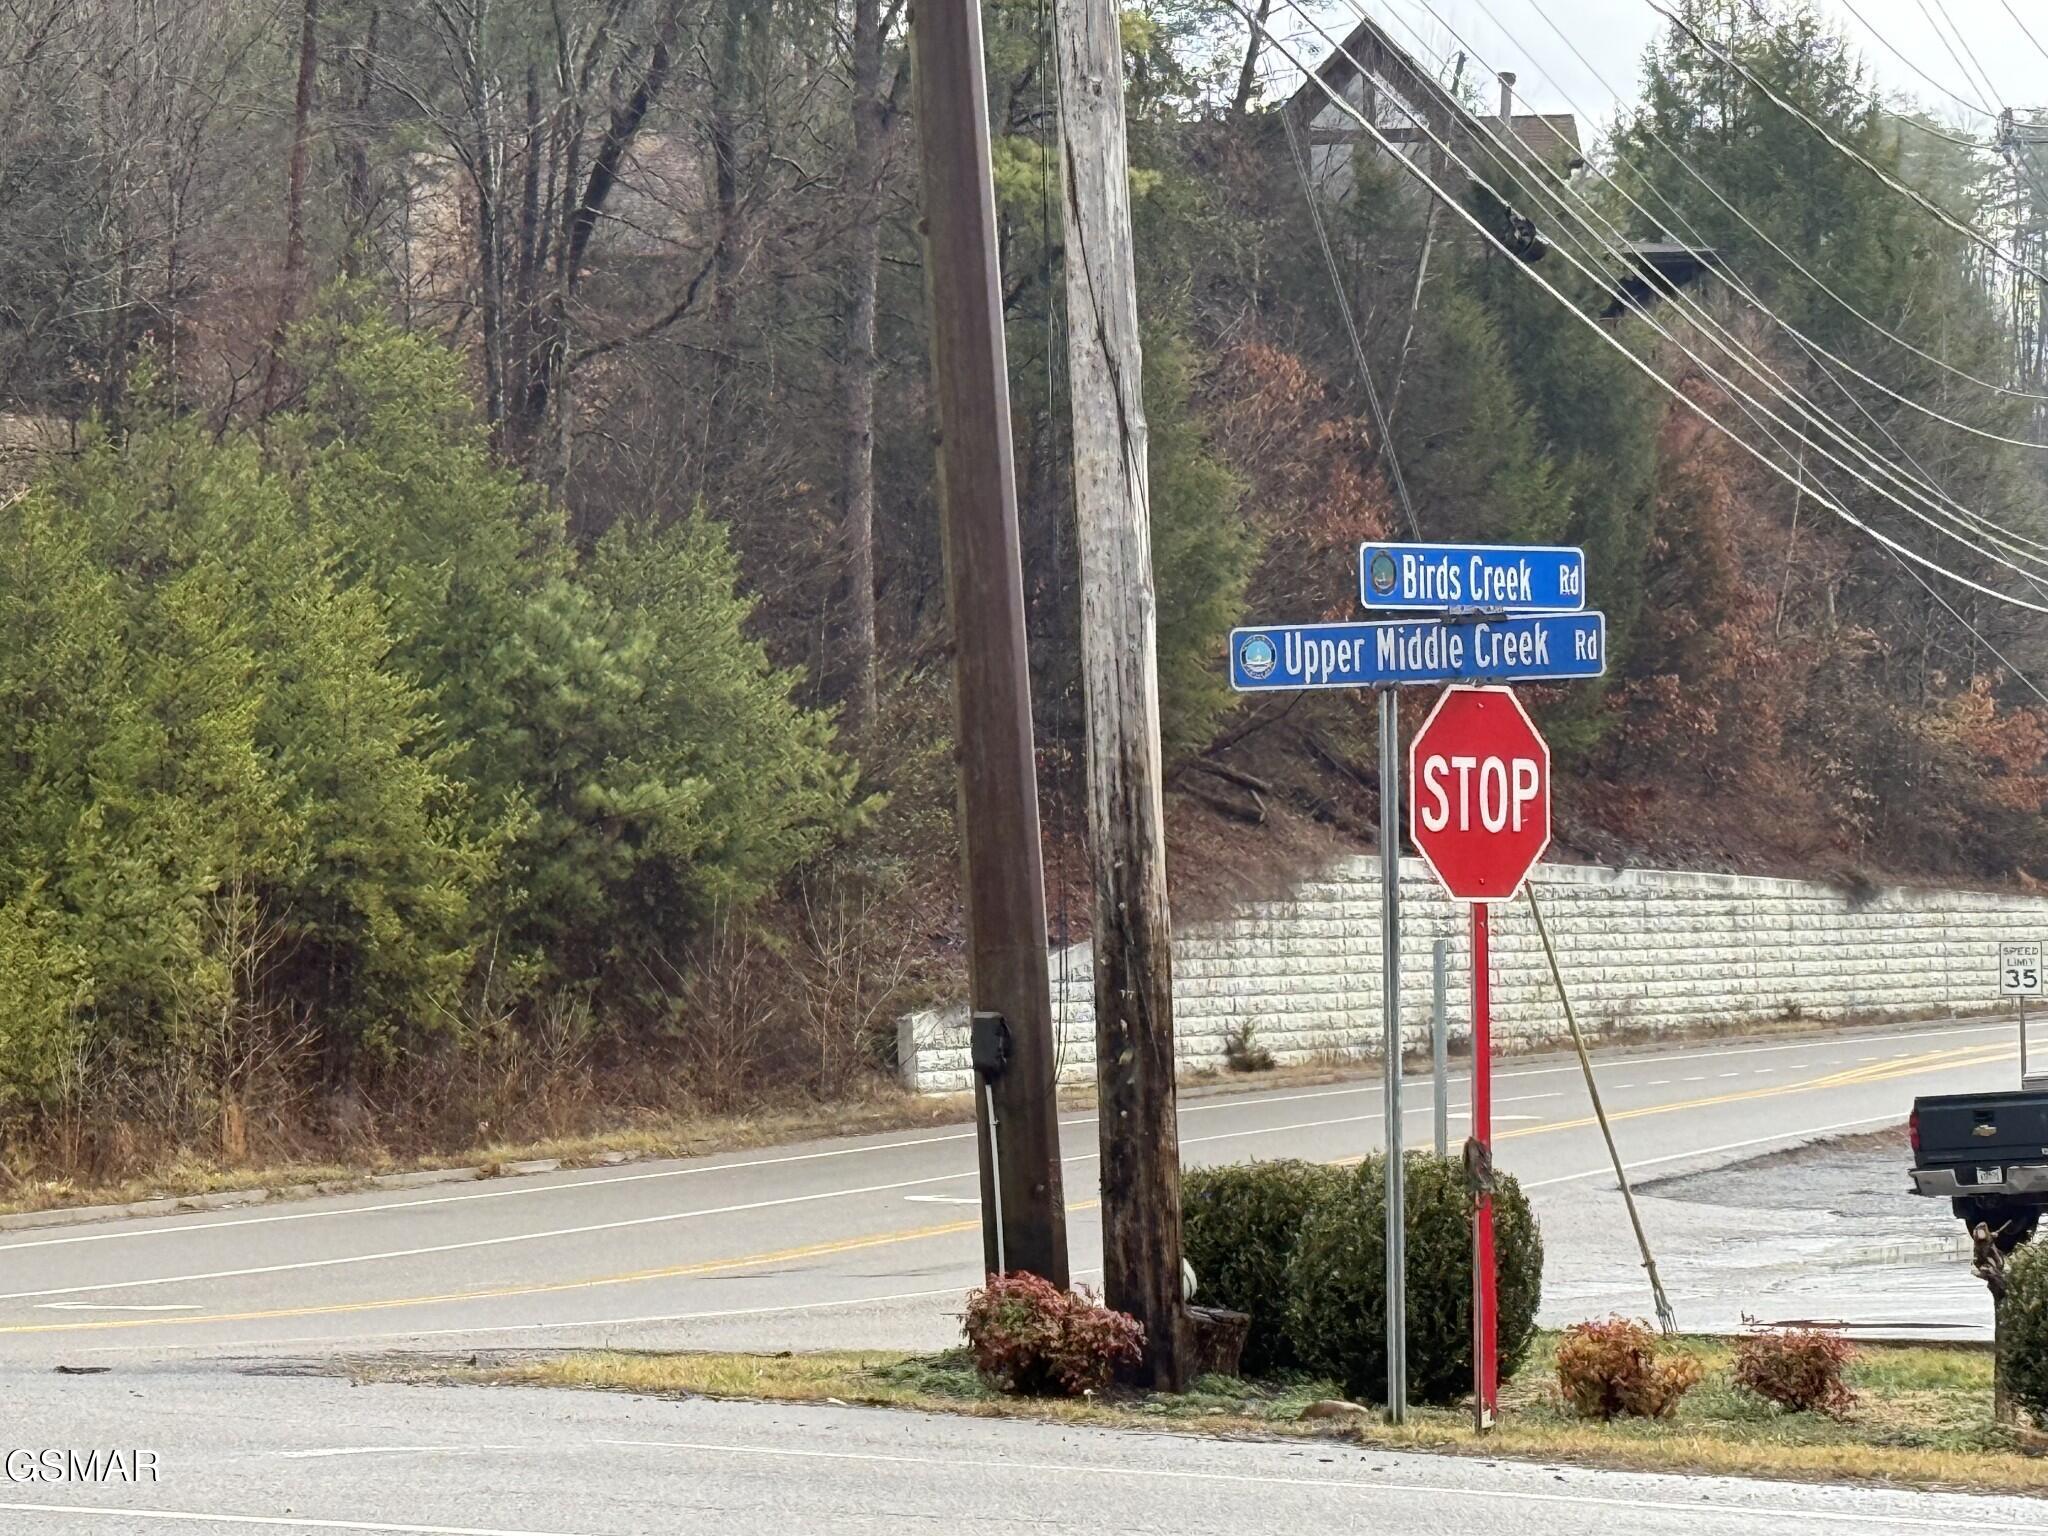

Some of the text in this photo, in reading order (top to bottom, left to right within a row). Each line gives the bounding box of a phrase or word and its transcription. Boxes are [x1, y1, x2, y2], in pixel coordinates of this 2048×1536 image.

[1403, 554, 1579, 601] Birds Creek Rd
[1284, 631, 1365, 684] Upper
[1376, 625, 1465, 672] Middle
[1474, 622, 1550, 668] Creek
[1574, 628, 1598, 661] Rd
[1421, 754, 1540, 834] STOP
[2003, 946, 2039, 956] SPEED
[2007, 958, 2034, 967] LIMIT
[2004, 968, 2038, 989] 35
